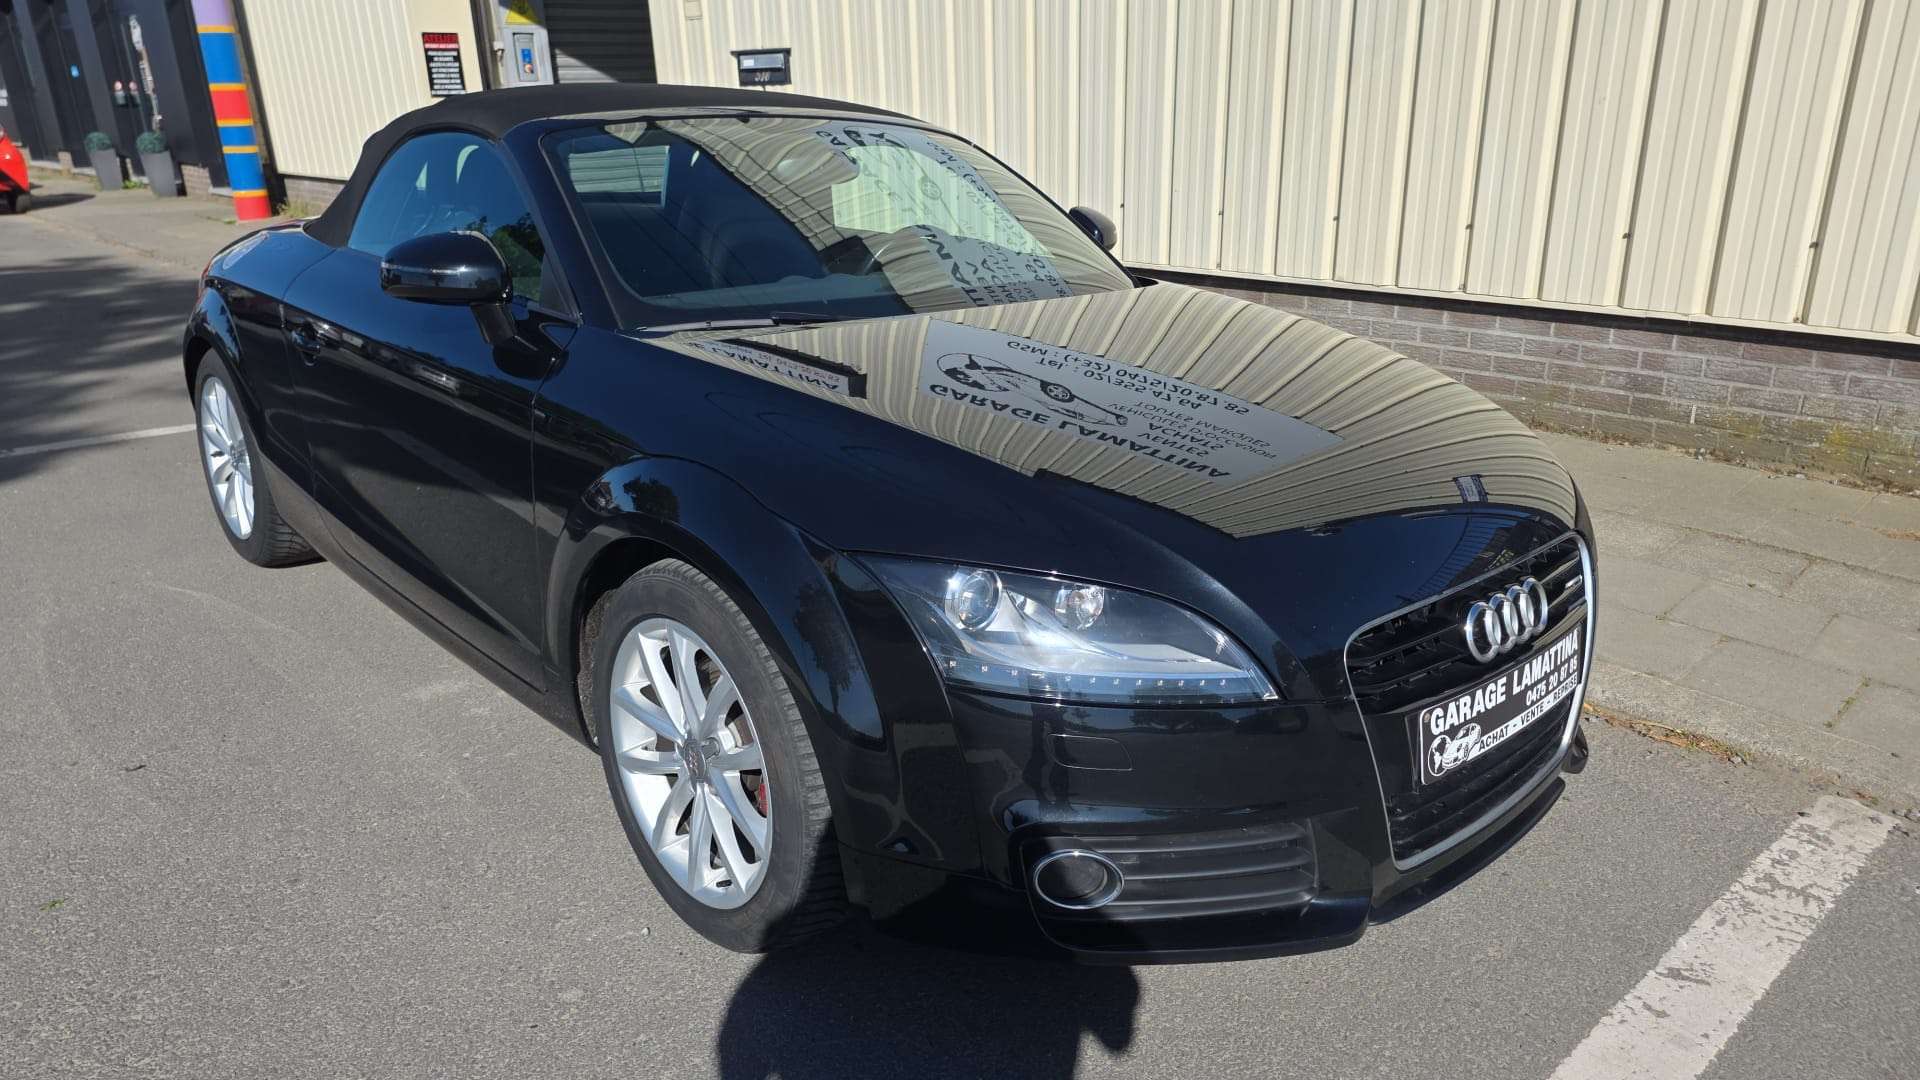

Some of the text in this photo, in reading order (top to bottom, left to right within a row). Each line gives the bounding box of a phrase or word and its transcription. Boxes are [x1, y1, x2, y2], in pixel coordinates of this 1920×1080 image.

[1430, 628, 1578, 736] GARAGE LAMATTINA
[1479, 723, 1510, 750] ACHAT
[1520, 704, 1544, 726] VENTE
[1553, 675, 1578, 702] REPRISE
[1526, 683, 1546, 706] 0475
[1549, 674, 1558, 692] 20
